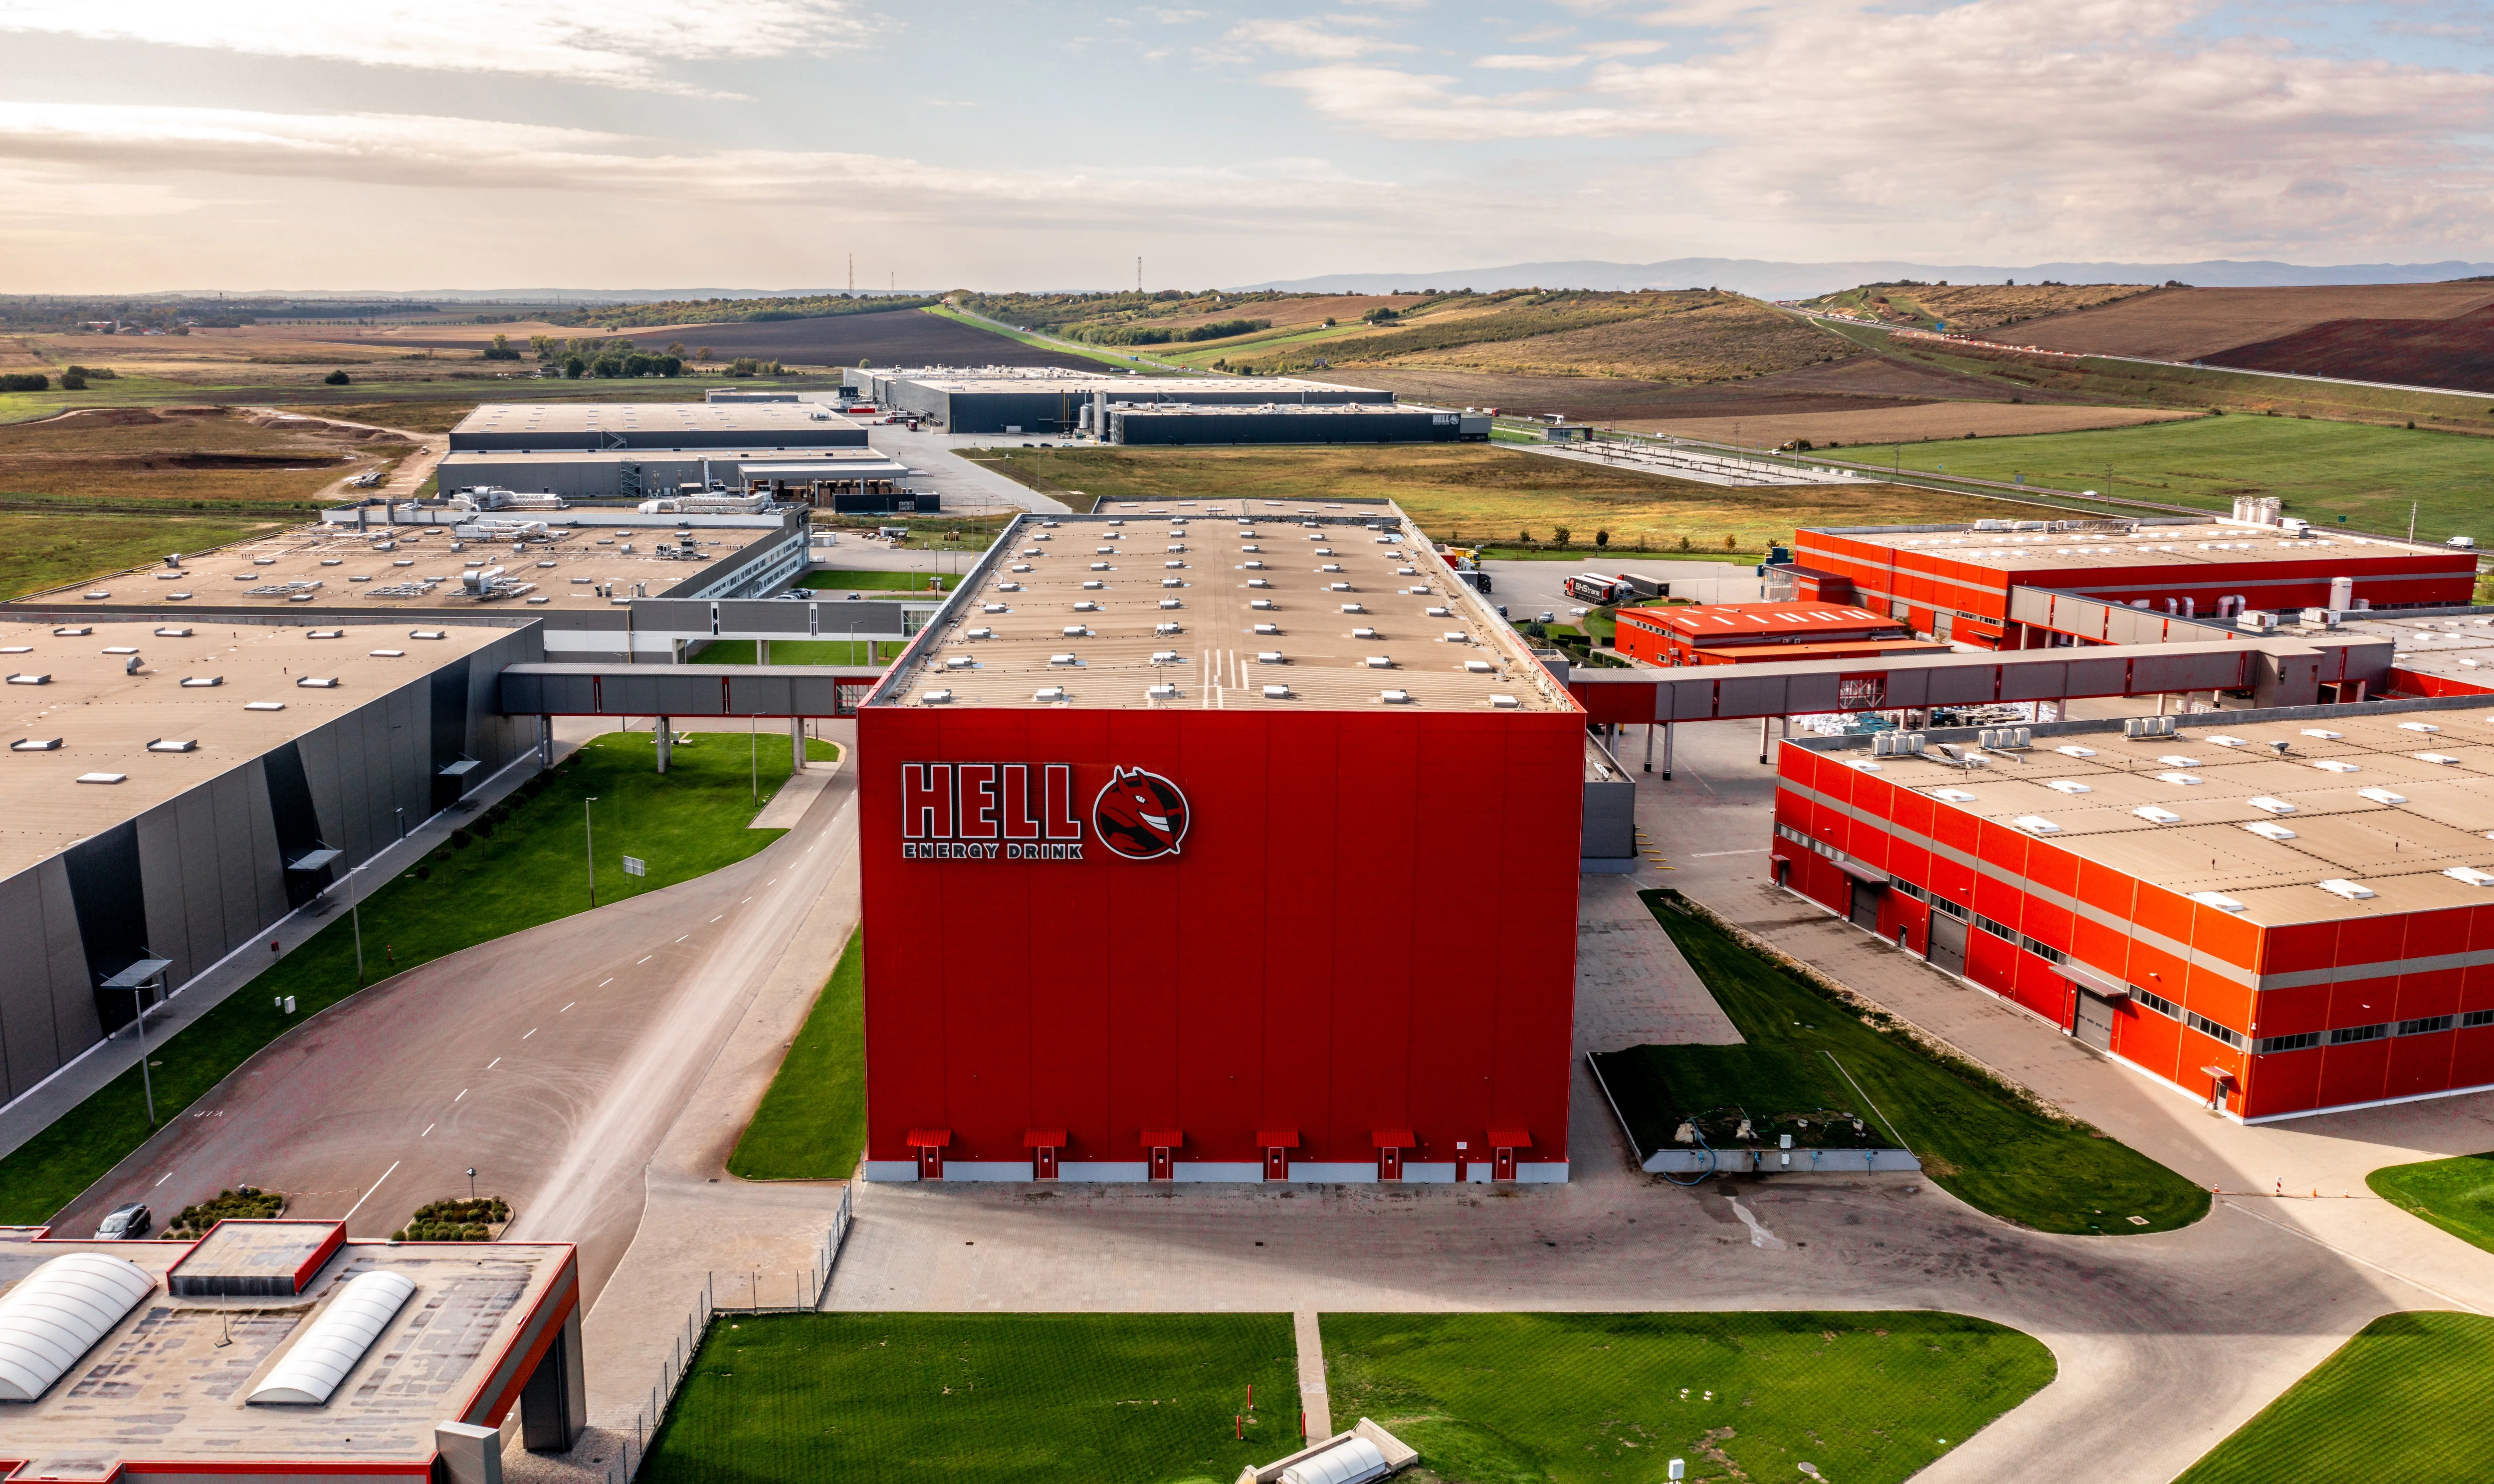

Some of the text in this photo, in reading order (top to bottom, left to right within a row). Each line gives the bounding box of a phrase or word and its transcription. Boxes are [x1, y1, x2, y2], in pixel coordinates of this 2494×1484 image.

[1575, 583, 1600, 596] BHStrans
[902, 763, 1082, 839] HELL
[903, 843, 1083, 859] ENERGY DRINK
